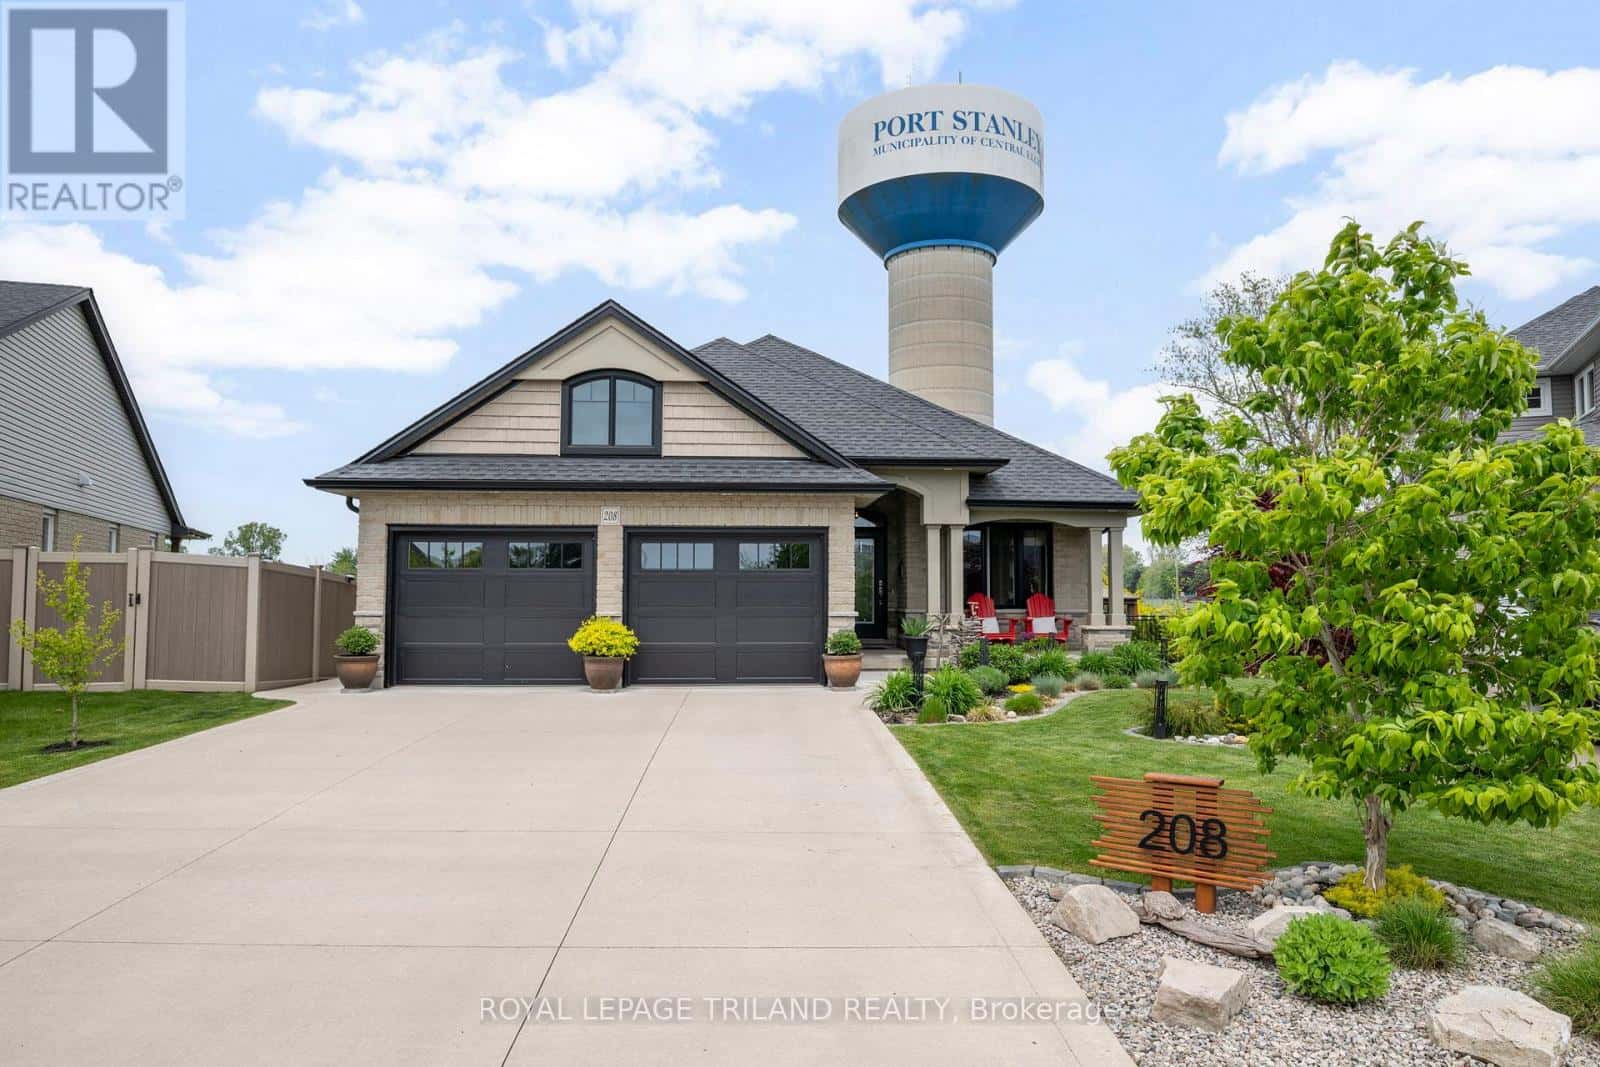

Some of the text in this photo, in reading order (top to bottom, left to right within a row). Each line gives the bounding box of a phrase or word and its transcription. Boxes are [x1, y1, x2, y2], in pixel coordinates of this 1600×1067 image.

[873, 110, 944, 142] PORT
[872, 135, 958, 157] MUNICIPALITY
[961, 135, 977, 146] OF
[1138, 810, 1228, 860] 208
